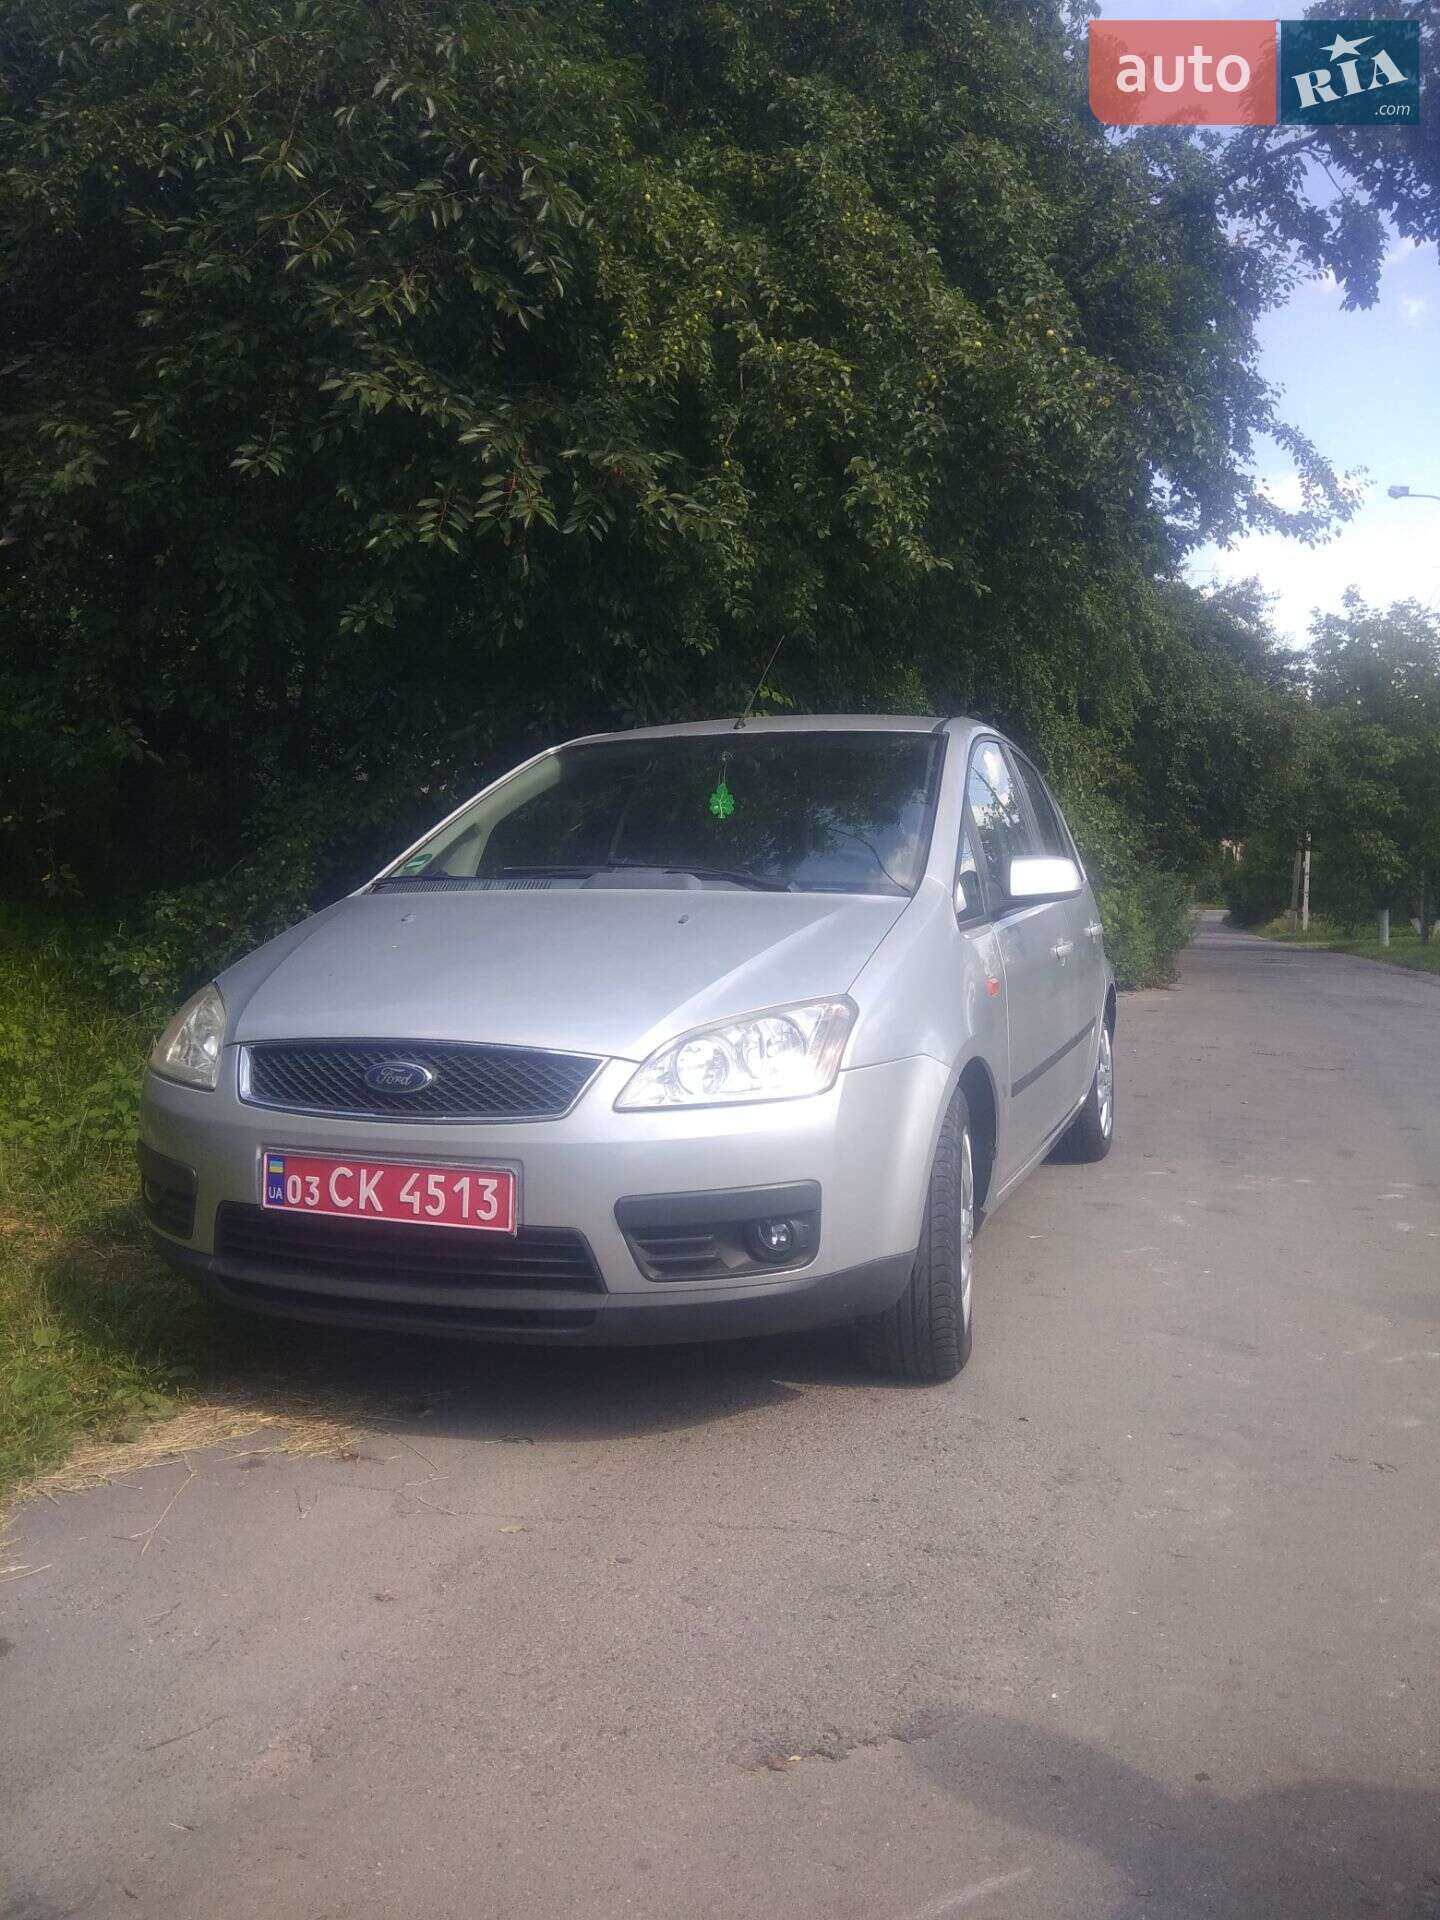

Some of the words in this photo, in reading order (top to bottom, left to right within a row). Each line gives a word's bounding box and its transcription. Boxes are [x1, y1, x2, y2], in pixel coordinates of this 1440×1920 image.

[376, 1067, 414, 1086] Ford
[268, 1187, 284, 1200] UA
[286, 1174, 320, 1206] 03
[328, 1166, 385, 1212] CK
[399, 1172, 498, 1221] 4513
